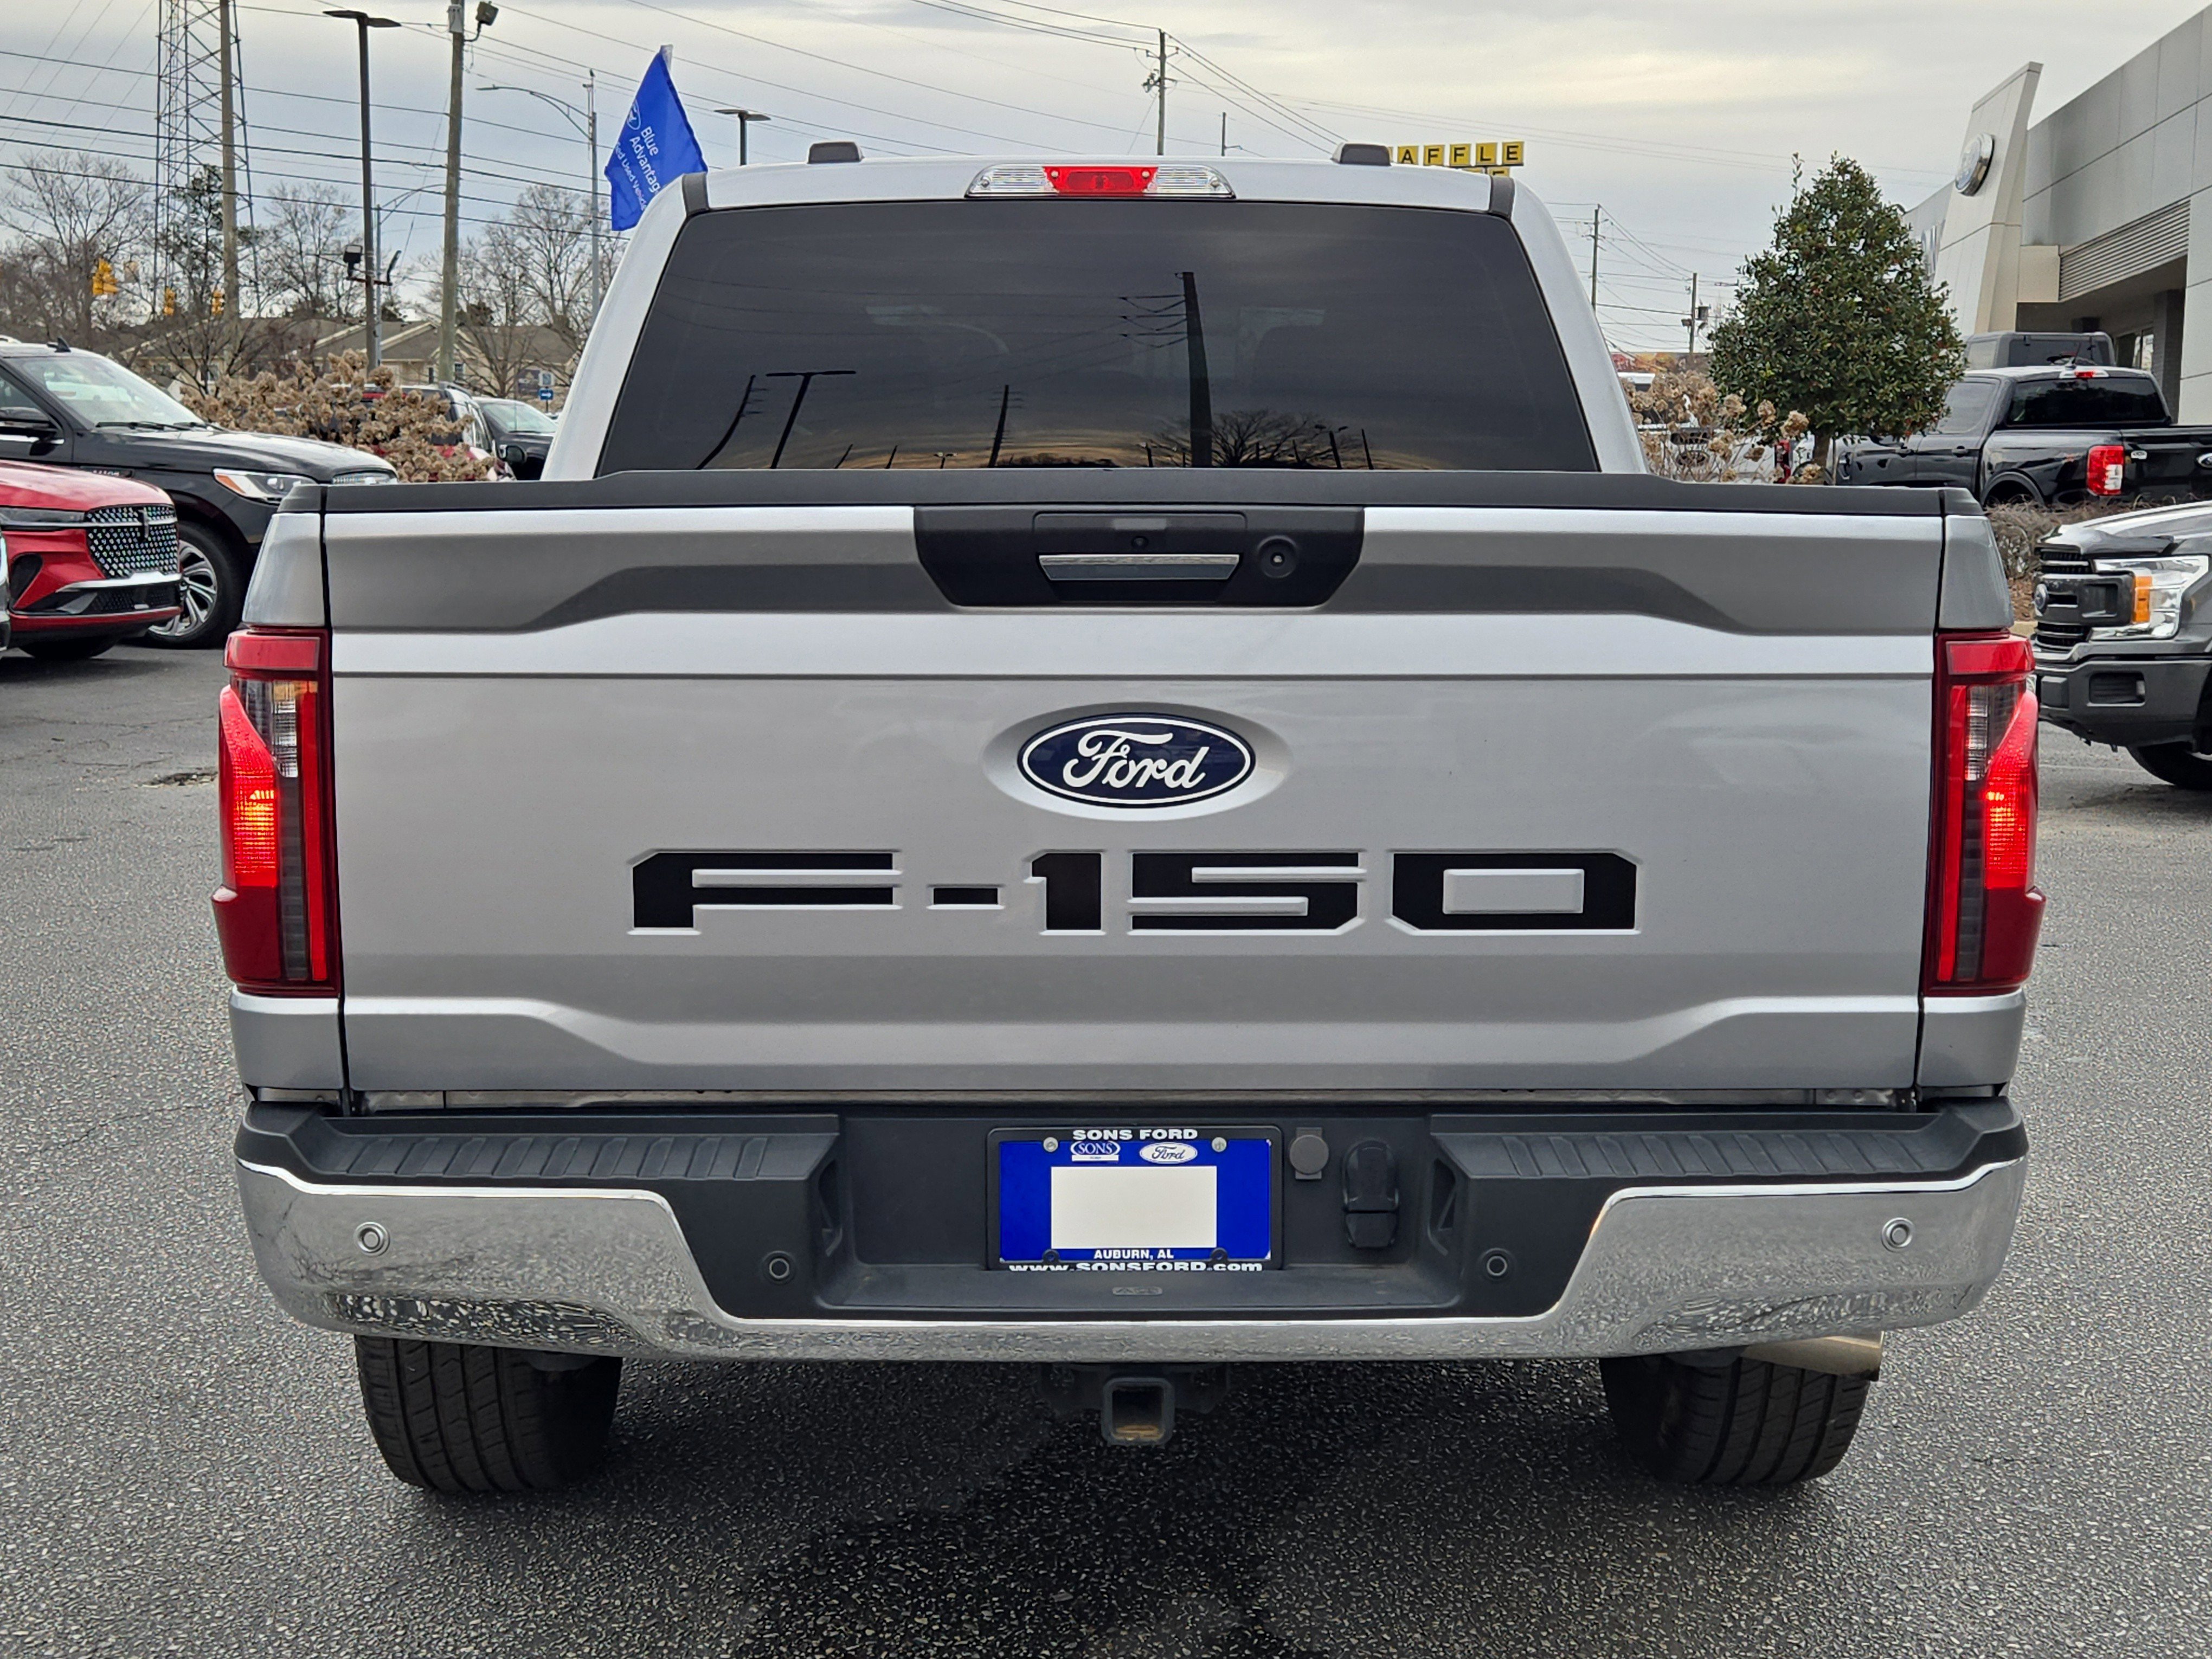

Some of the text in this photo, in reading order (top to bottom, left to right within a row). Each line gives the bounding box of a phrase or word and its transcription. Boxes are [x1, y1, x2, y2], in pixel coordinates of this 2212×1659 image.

[641, 126, 659, 156] Blue
[1400, 145, 1519, 164] AFFLE
[622, 158, 635, 182] Used
[629, 136, 661, 195] Advantag
[1063, 729, 1210, 789] Ford
[629, 851, 1638, 934] F-150
[1072, 1129, 1198, 1140] SONS FORD
[1077, 1142, 1113, 1155] SONS
[1151, 1146, 1186, 1160] Ford
[1094, 1249, 1174, 1260] AUBURN, AL
[1009, 1262, 1263, 1271] www.SONSFORD.com
